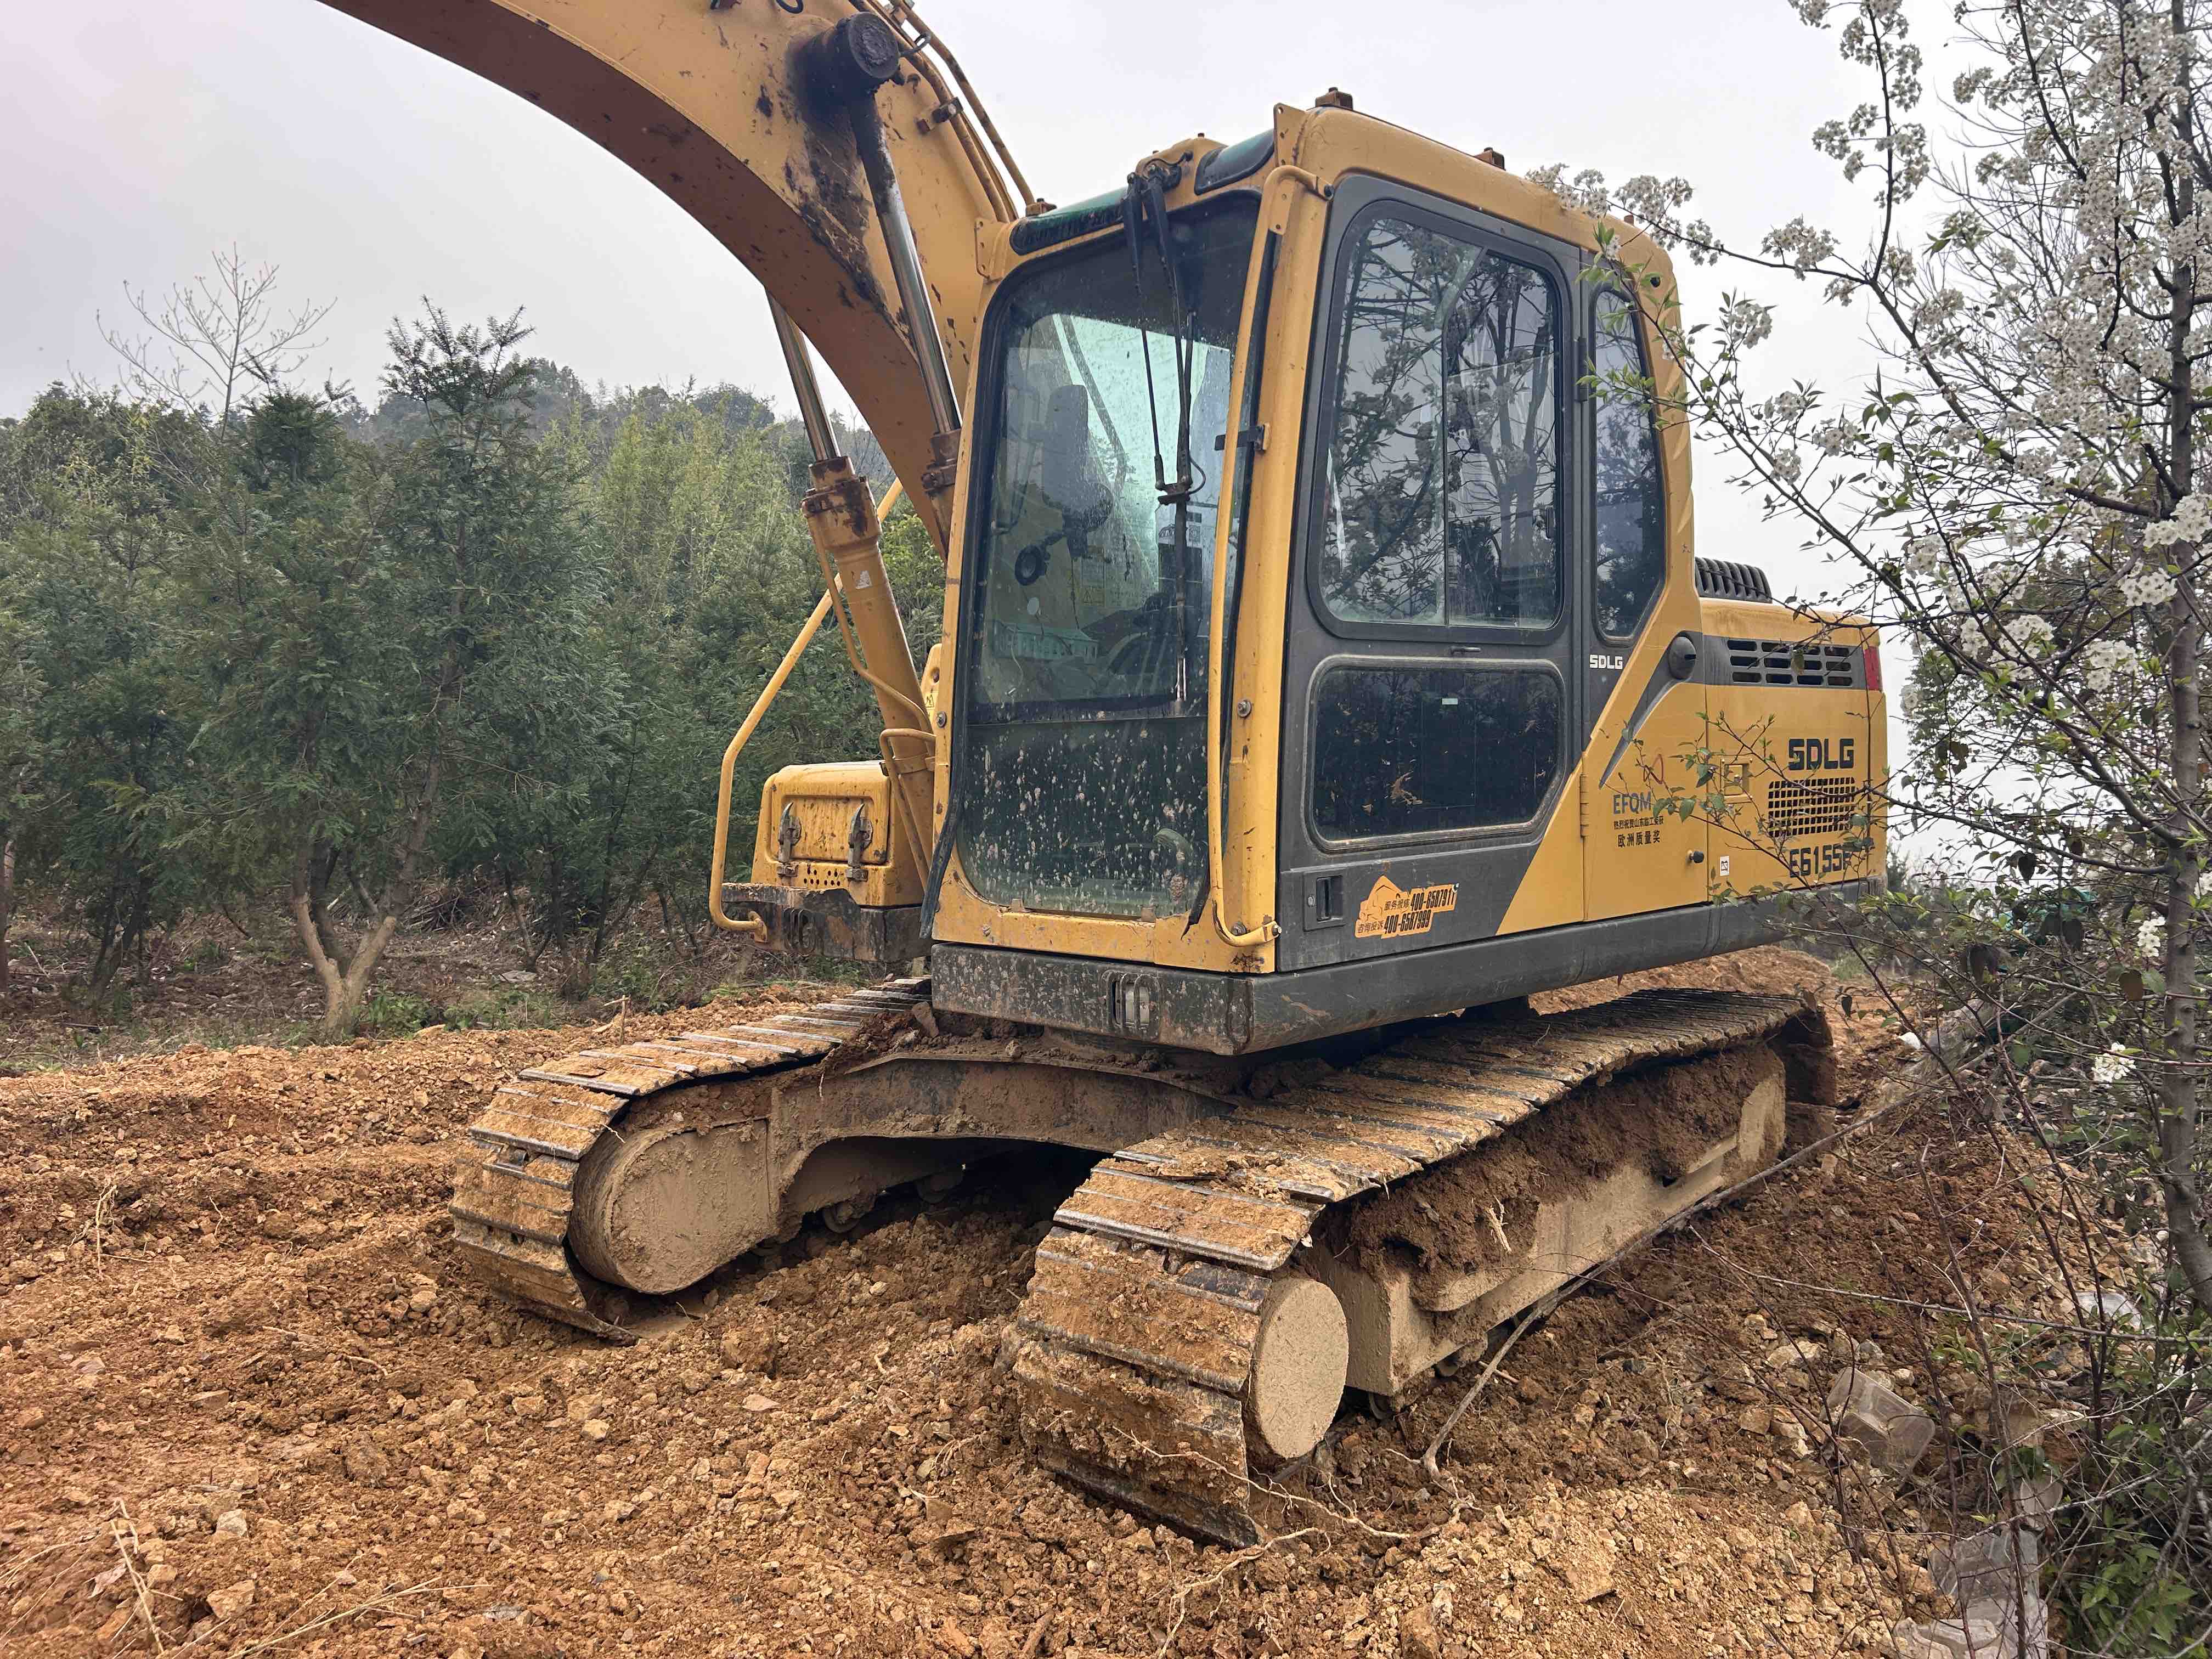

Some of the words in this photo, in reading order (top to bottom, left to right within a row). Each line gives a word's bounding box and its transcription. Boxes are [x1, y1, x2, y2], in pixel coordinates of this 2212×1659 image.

[1589, 654, 1623, 669] SDLG
[1788, 738, 1854, 770] SDLG
[1613, 792, 1651, 814] EFQM
[1618, 830, 1660, 847] 欧洲质量奖
[1384, 910, 1431, 934] 400-6587999
